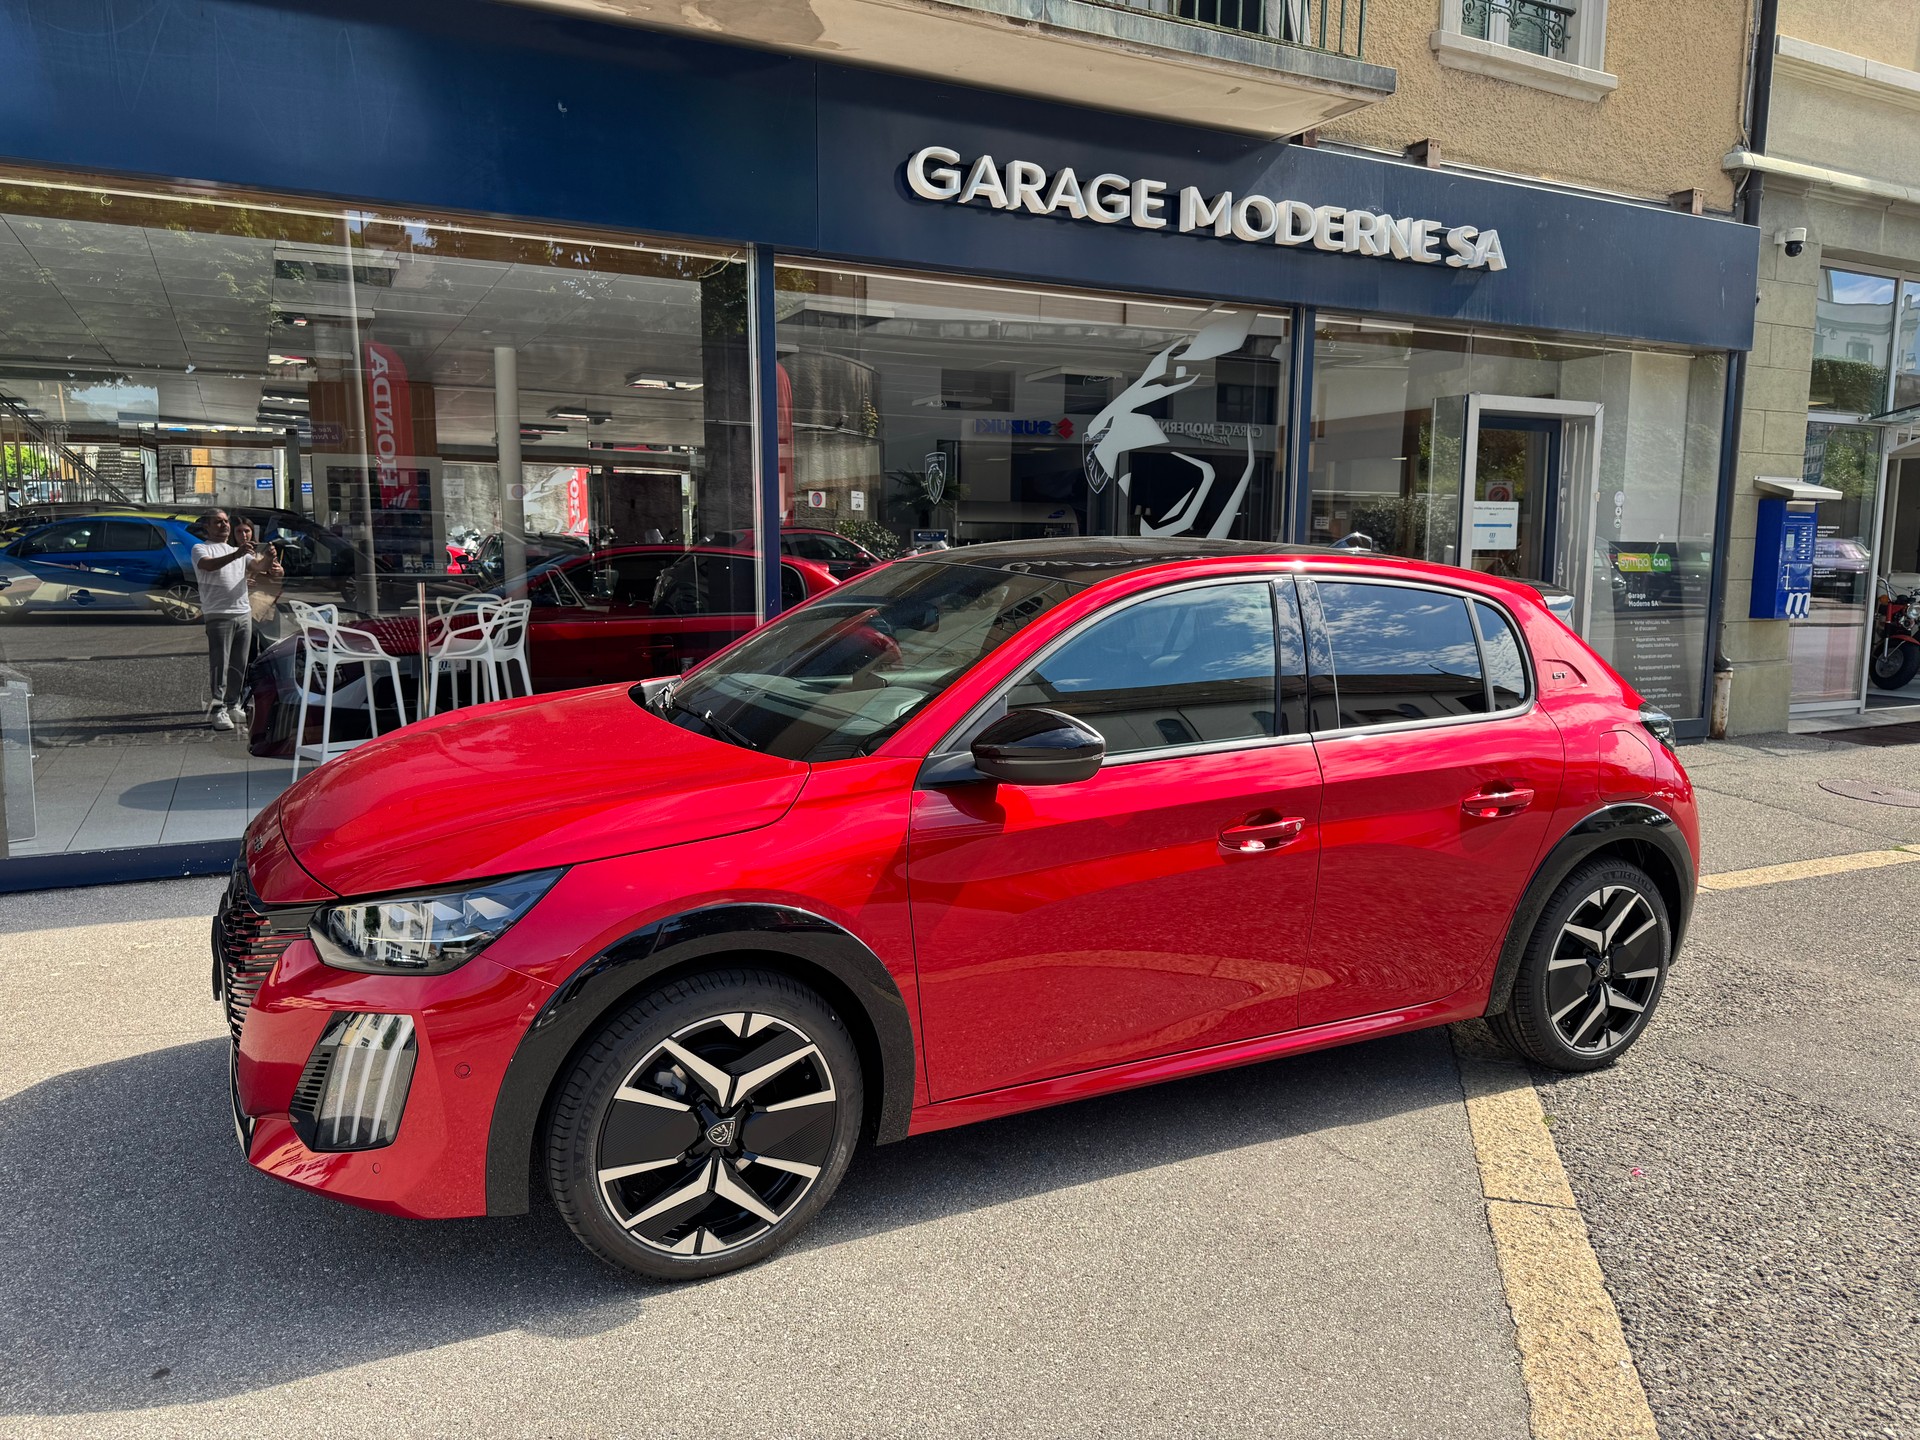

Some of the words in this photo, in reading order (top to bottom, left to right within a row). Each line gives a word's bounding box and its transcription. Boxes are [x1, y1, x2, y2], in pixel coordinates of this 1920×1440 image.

[907, 146, 1167, 228] GARAGE
[1179, 186, 1442, 263] MODERNE
[1445, 225, 1508, 271] SA
[1627, 592, 1646, 600] Garage
[574, 1061, 618, 1155] MICHELIN
